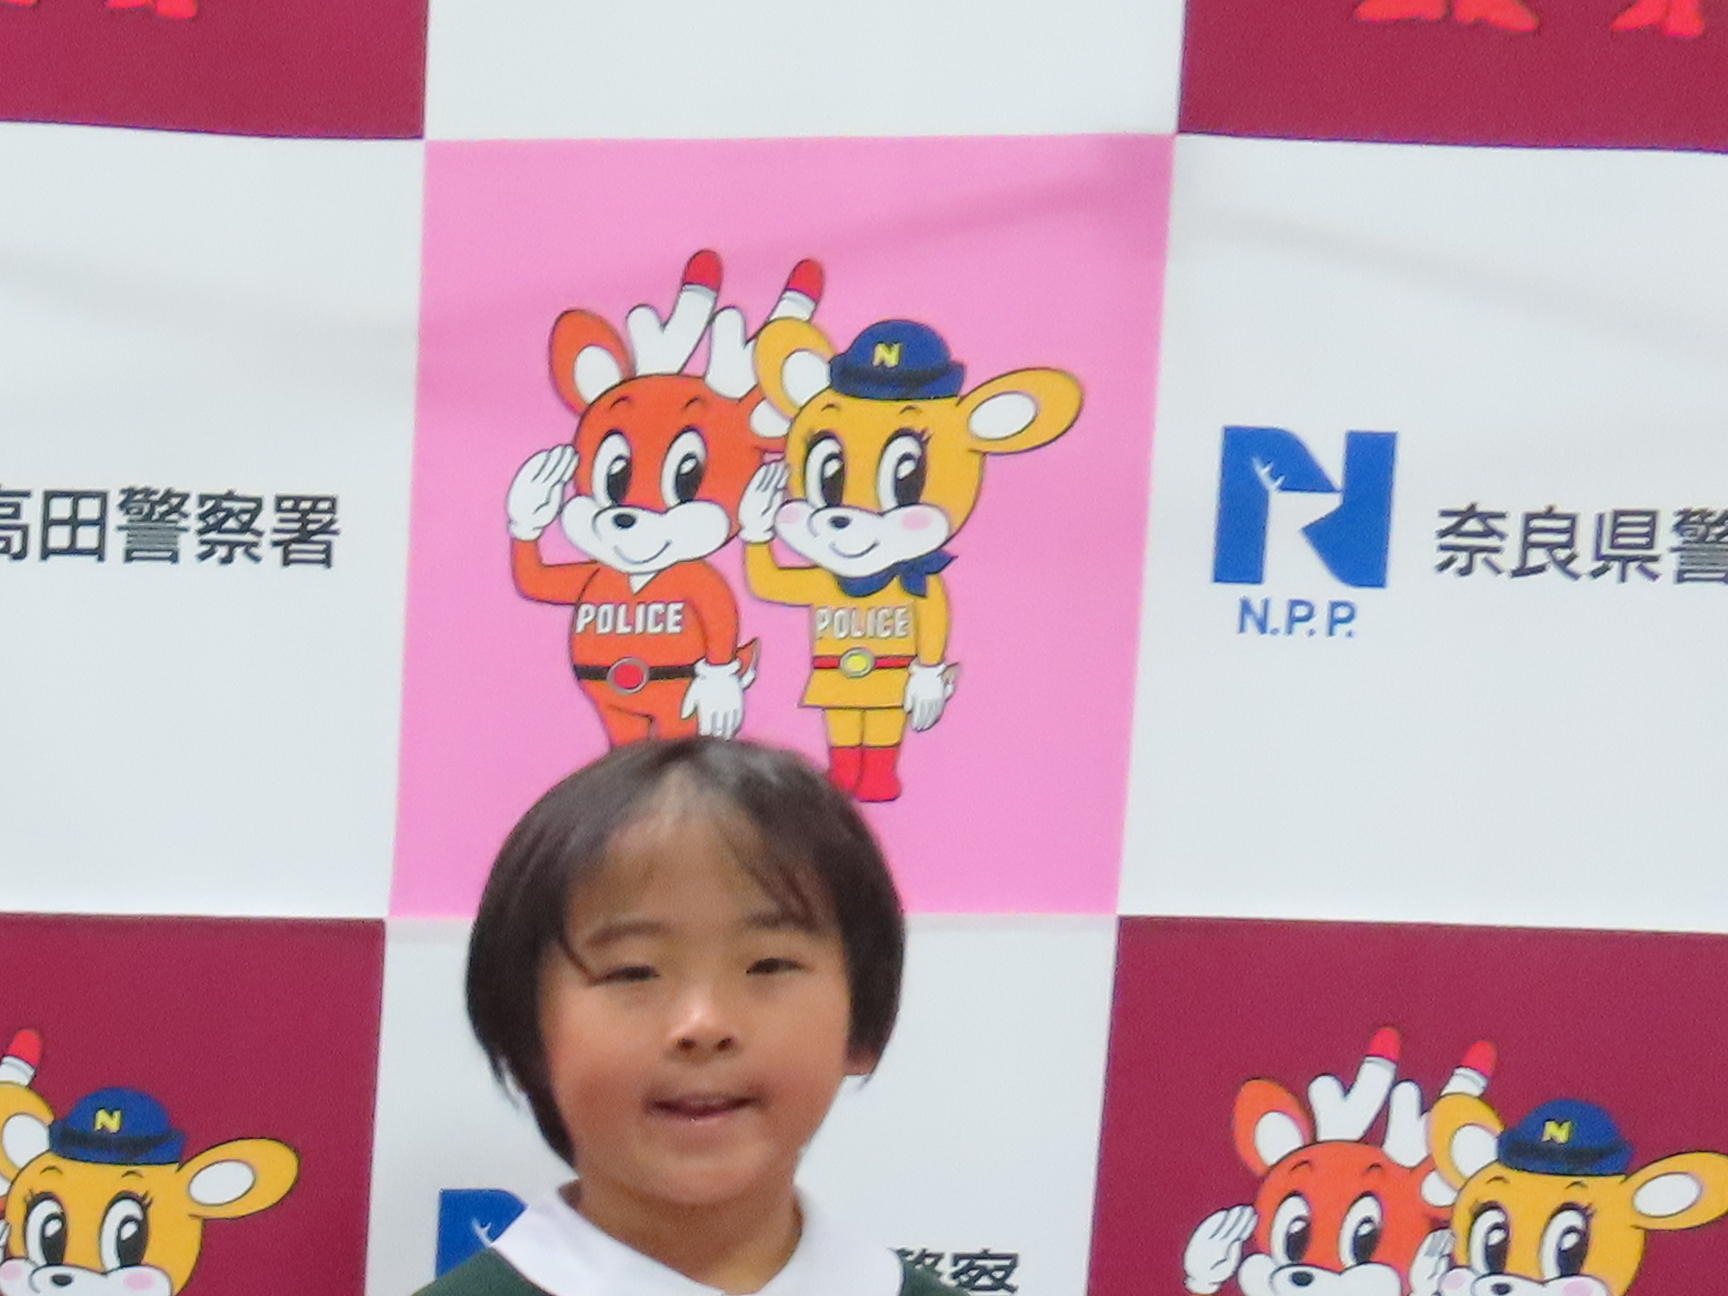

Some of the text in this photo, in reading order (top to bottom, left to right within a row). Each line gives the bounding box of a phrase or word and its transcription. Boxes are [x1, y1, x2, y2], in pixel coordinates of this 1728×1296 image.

[575, 602, 686, 635] POLICE
[816, 605, 911, 640] POLICE
[1239, 598, 1358, 638] N.P.P.
